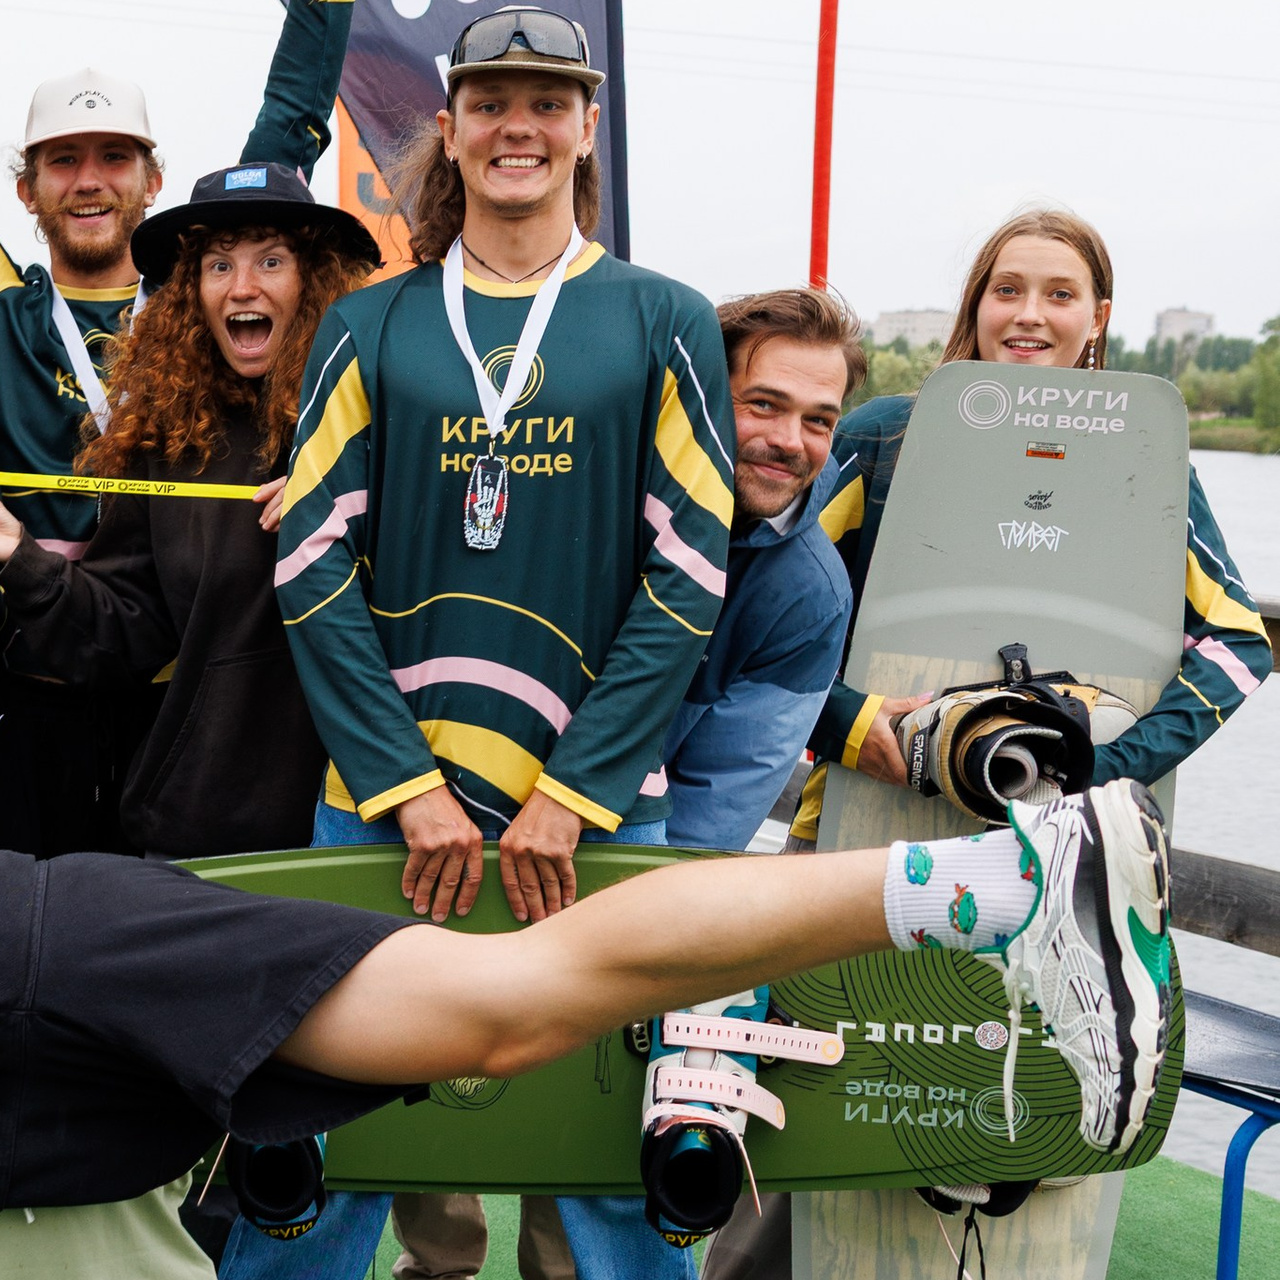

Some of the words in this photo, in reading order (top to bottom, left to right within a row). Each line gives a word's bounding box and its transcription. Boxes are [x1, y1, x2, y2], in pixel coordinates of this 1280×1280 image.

[1017, 386, 1129, 412] КРУГИ
[442, 416, 574, 445] КРУГИ
[1013, 412, 1050, 428] на
[1055, 414, 1126, 435] воде
[93, 480, 114, 490] VIP
[154, 483, 176, 494] VIP
[845, 1079, 920, 1100] воде
[928, 1086, 967, 1102] на
[844, 1102, 964, 1129] КРУГИ
[660, 1232, 705, 1246] РУГ
